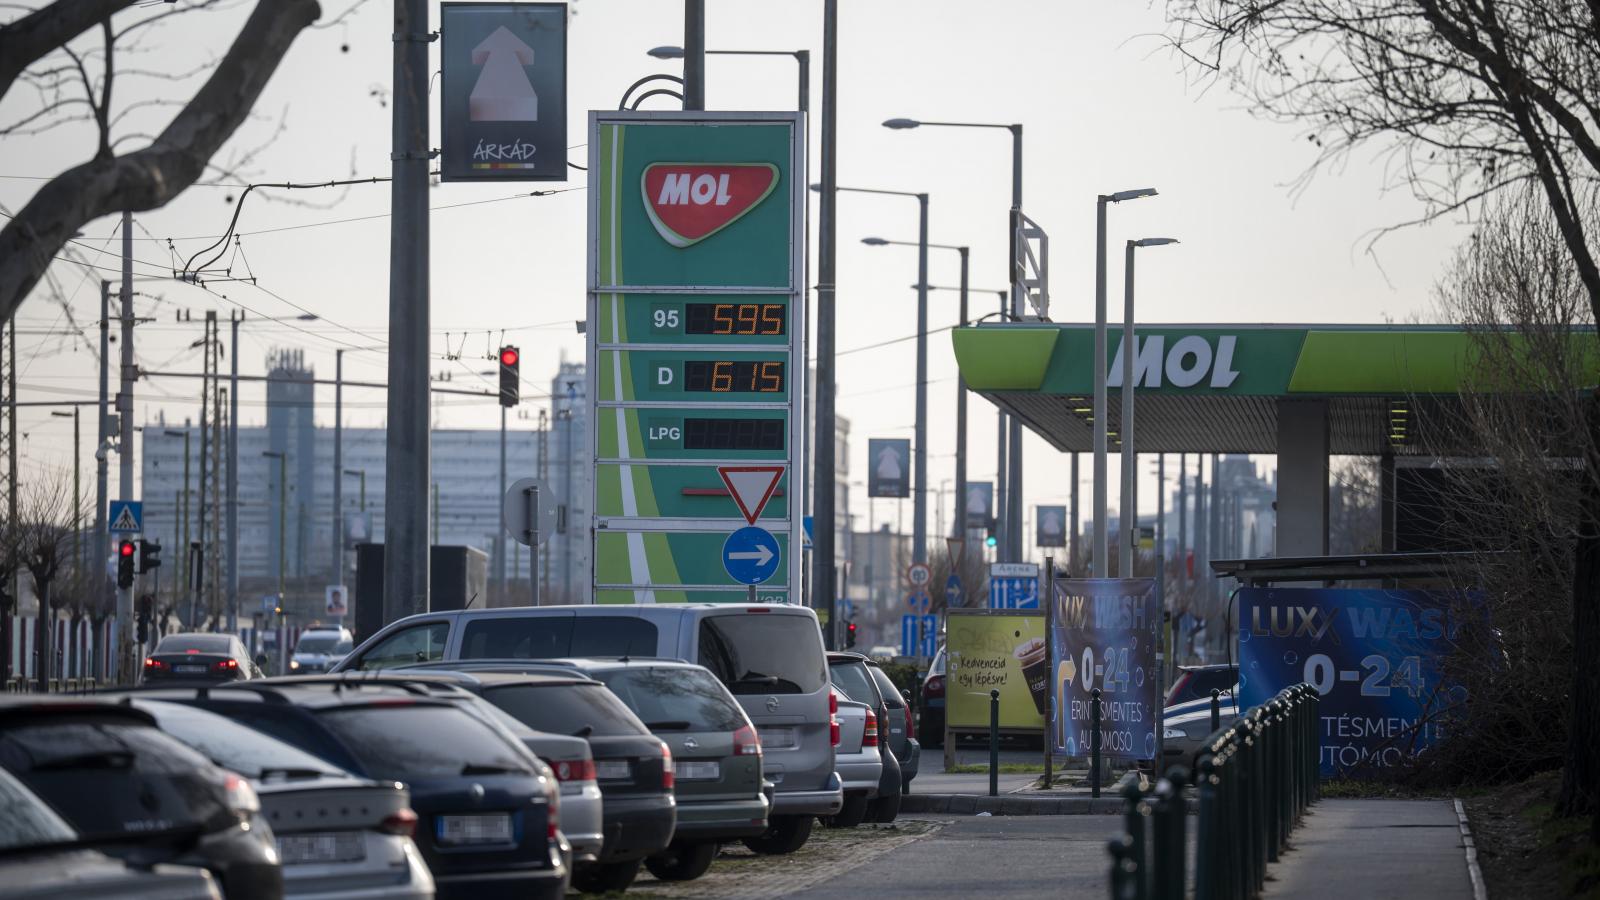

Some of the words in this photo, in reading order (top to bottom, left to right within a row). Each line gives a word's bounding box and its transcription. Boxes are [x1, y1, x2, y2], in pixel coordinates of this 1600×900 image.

[473, 138, 537, 161] ÁRKÁD
[657, 173, 732, 206] MOL
[653, 309, 679, 328] 95
[712, 304, 784, 335] 595
[657, 366, 674, 386] D
[711, 361, 782, 392] 615
[1106, 335, 1241, 389] MOL
[649, 427, 681, 441] LPG
[960, 656, 1006, 669] Kedvenceid
[1081, 646, 1130, 693] 0-24
[1302, 653, 1426, 698] 0-24
[958, 673, 973, 688] egy
[975, 671, 1008, 687] lépésre!
[1071, 695, 1142, 722] ÉRINSMENTES
[1079, 726, 1133, 751] AUÓMOSÓ
